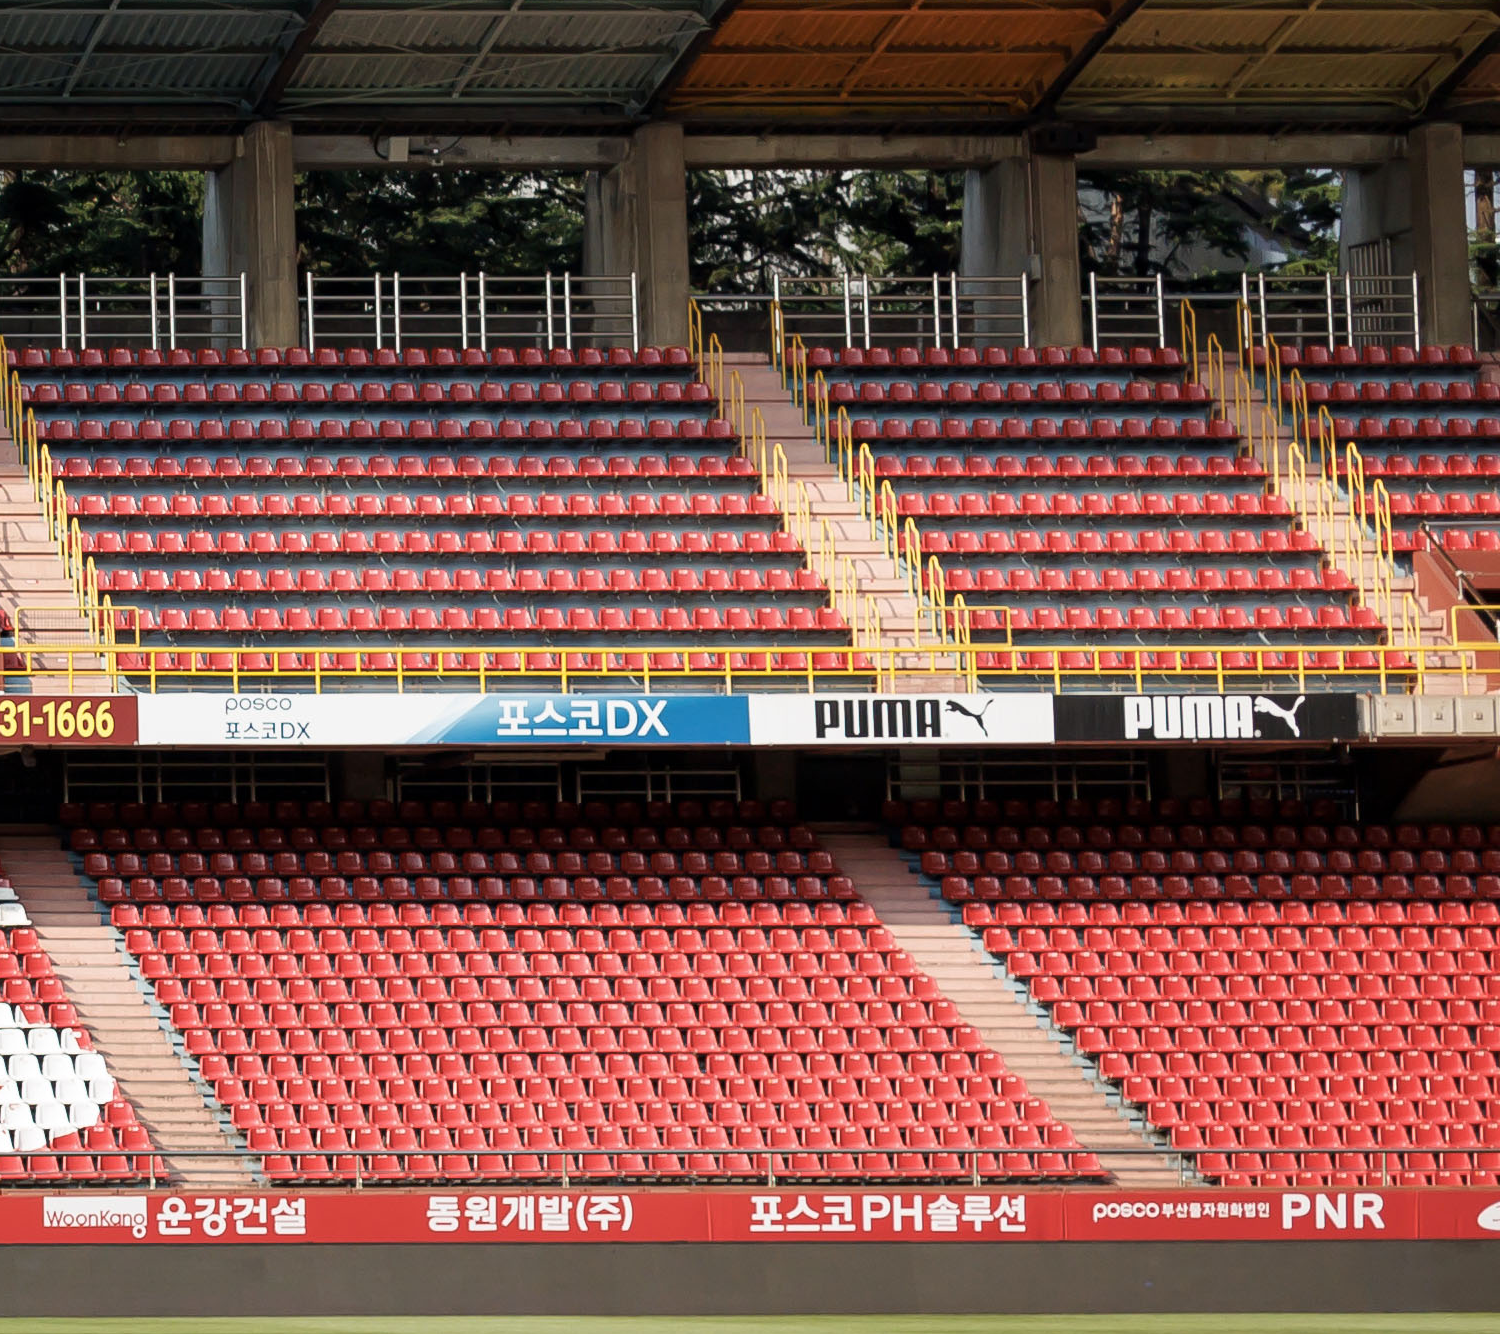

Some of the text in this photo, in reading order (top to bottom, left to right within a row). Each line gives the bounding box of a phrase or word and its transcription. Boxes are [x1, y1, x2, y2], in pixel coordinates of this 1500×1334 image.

[225, 697, 292, 715] posco
[496, 698, 670, 738] 포스코DX
[814, 699, 942, 739] PUMA
[1124, 695, 1258, 739] PUMA
[225, 721, 311, 740] 포스코DX
[46, 1209, 148, 1239] WoonKang
[156, 1197, 307, 1237] 운강건설
[426, 1195, 633, 1232] 동원개발(주)
[750, 1194, 1026, 1232] 포스코PH솔루션
[1093, 1202, 1160, 1223] posco
[1281, 1193, 1386, 1230] PNR
